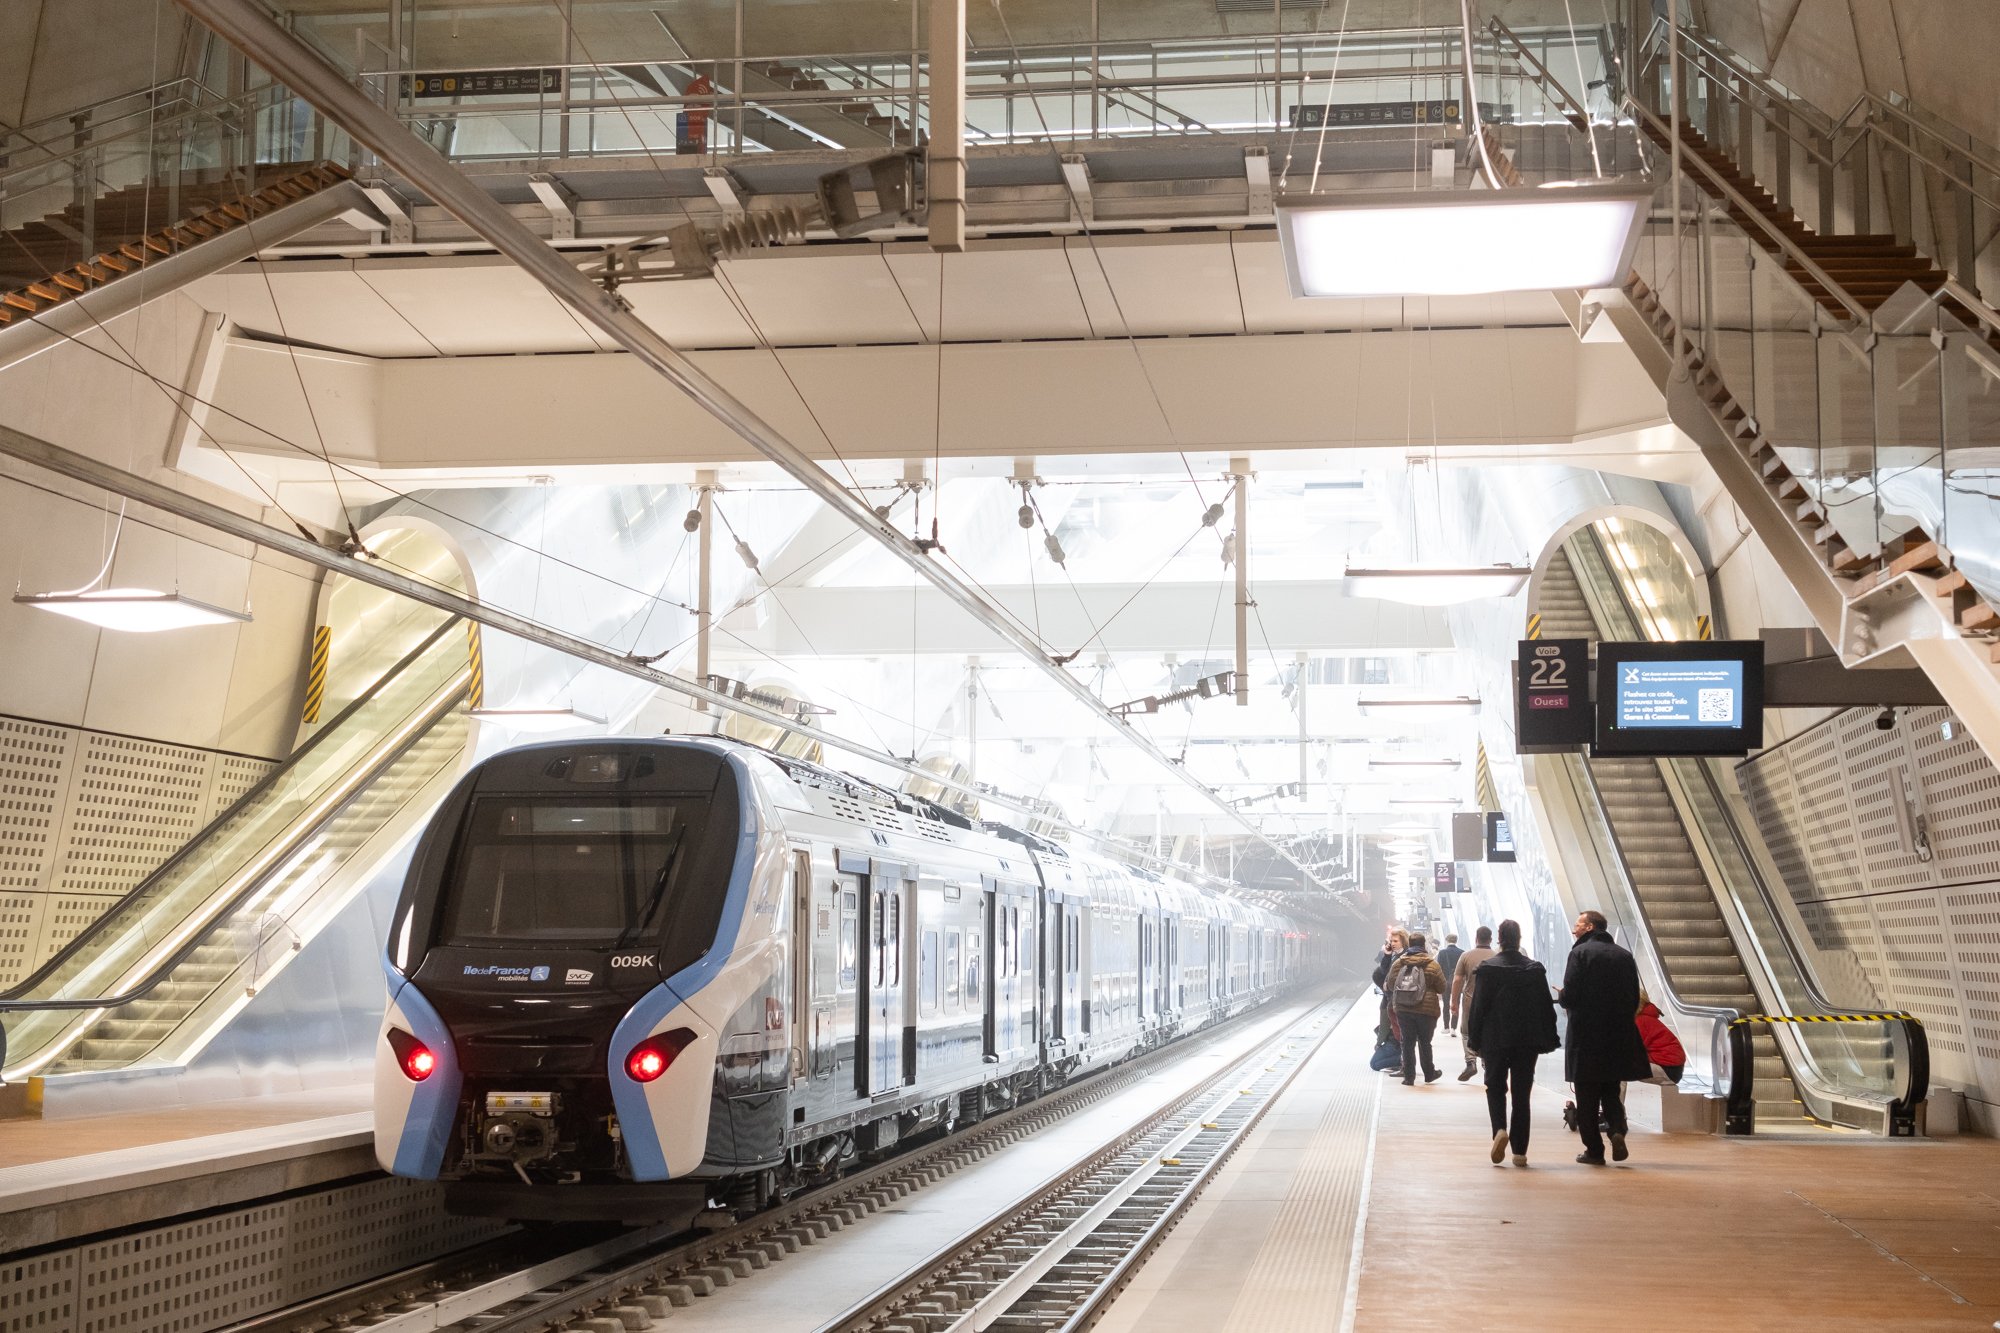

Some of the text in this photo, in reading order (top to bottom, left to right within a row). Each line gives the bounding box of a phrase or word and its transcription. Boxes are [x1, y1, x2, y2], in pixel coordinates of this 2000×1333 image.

[1530, 658, 1567, 685] 22
[1534, 697, 1564, 706] Ouest
[1437, 867, 1449, 875] 22
[611, 954, 655, 968] 009K
